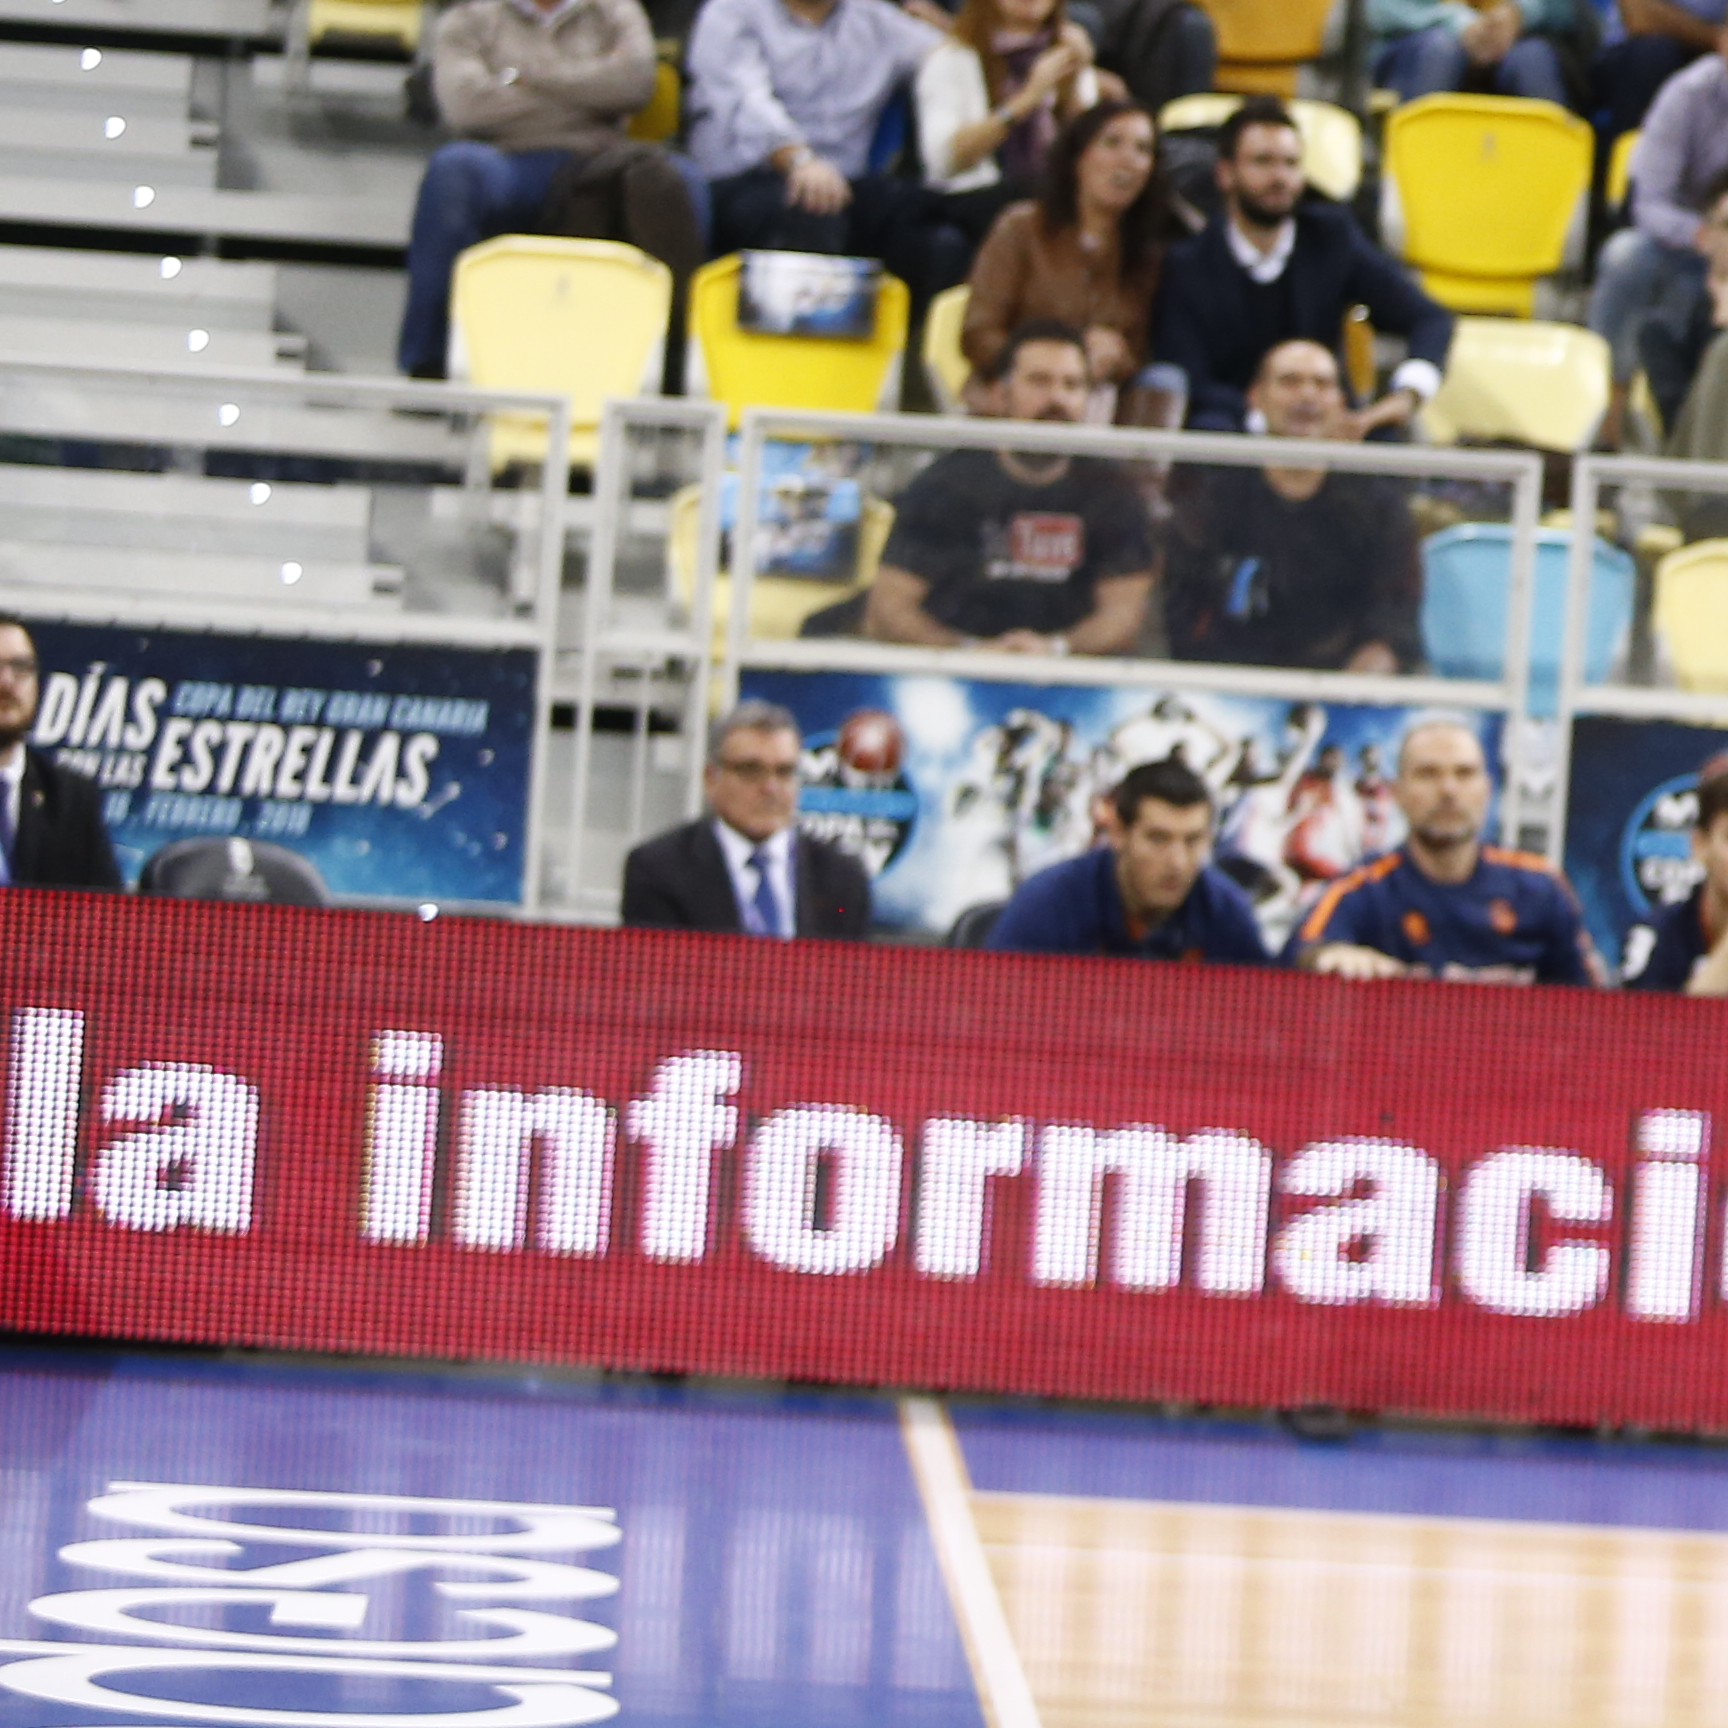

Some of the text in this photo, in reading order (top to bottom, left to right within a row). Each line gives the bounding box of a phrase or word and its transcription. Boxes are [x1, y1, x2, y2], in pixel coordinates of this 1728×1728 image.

[31, 660, 167, 751] DÍAS
[149, 717, 440, 809] ESTRELLAS
[3, 1007, 259, 1237] la
